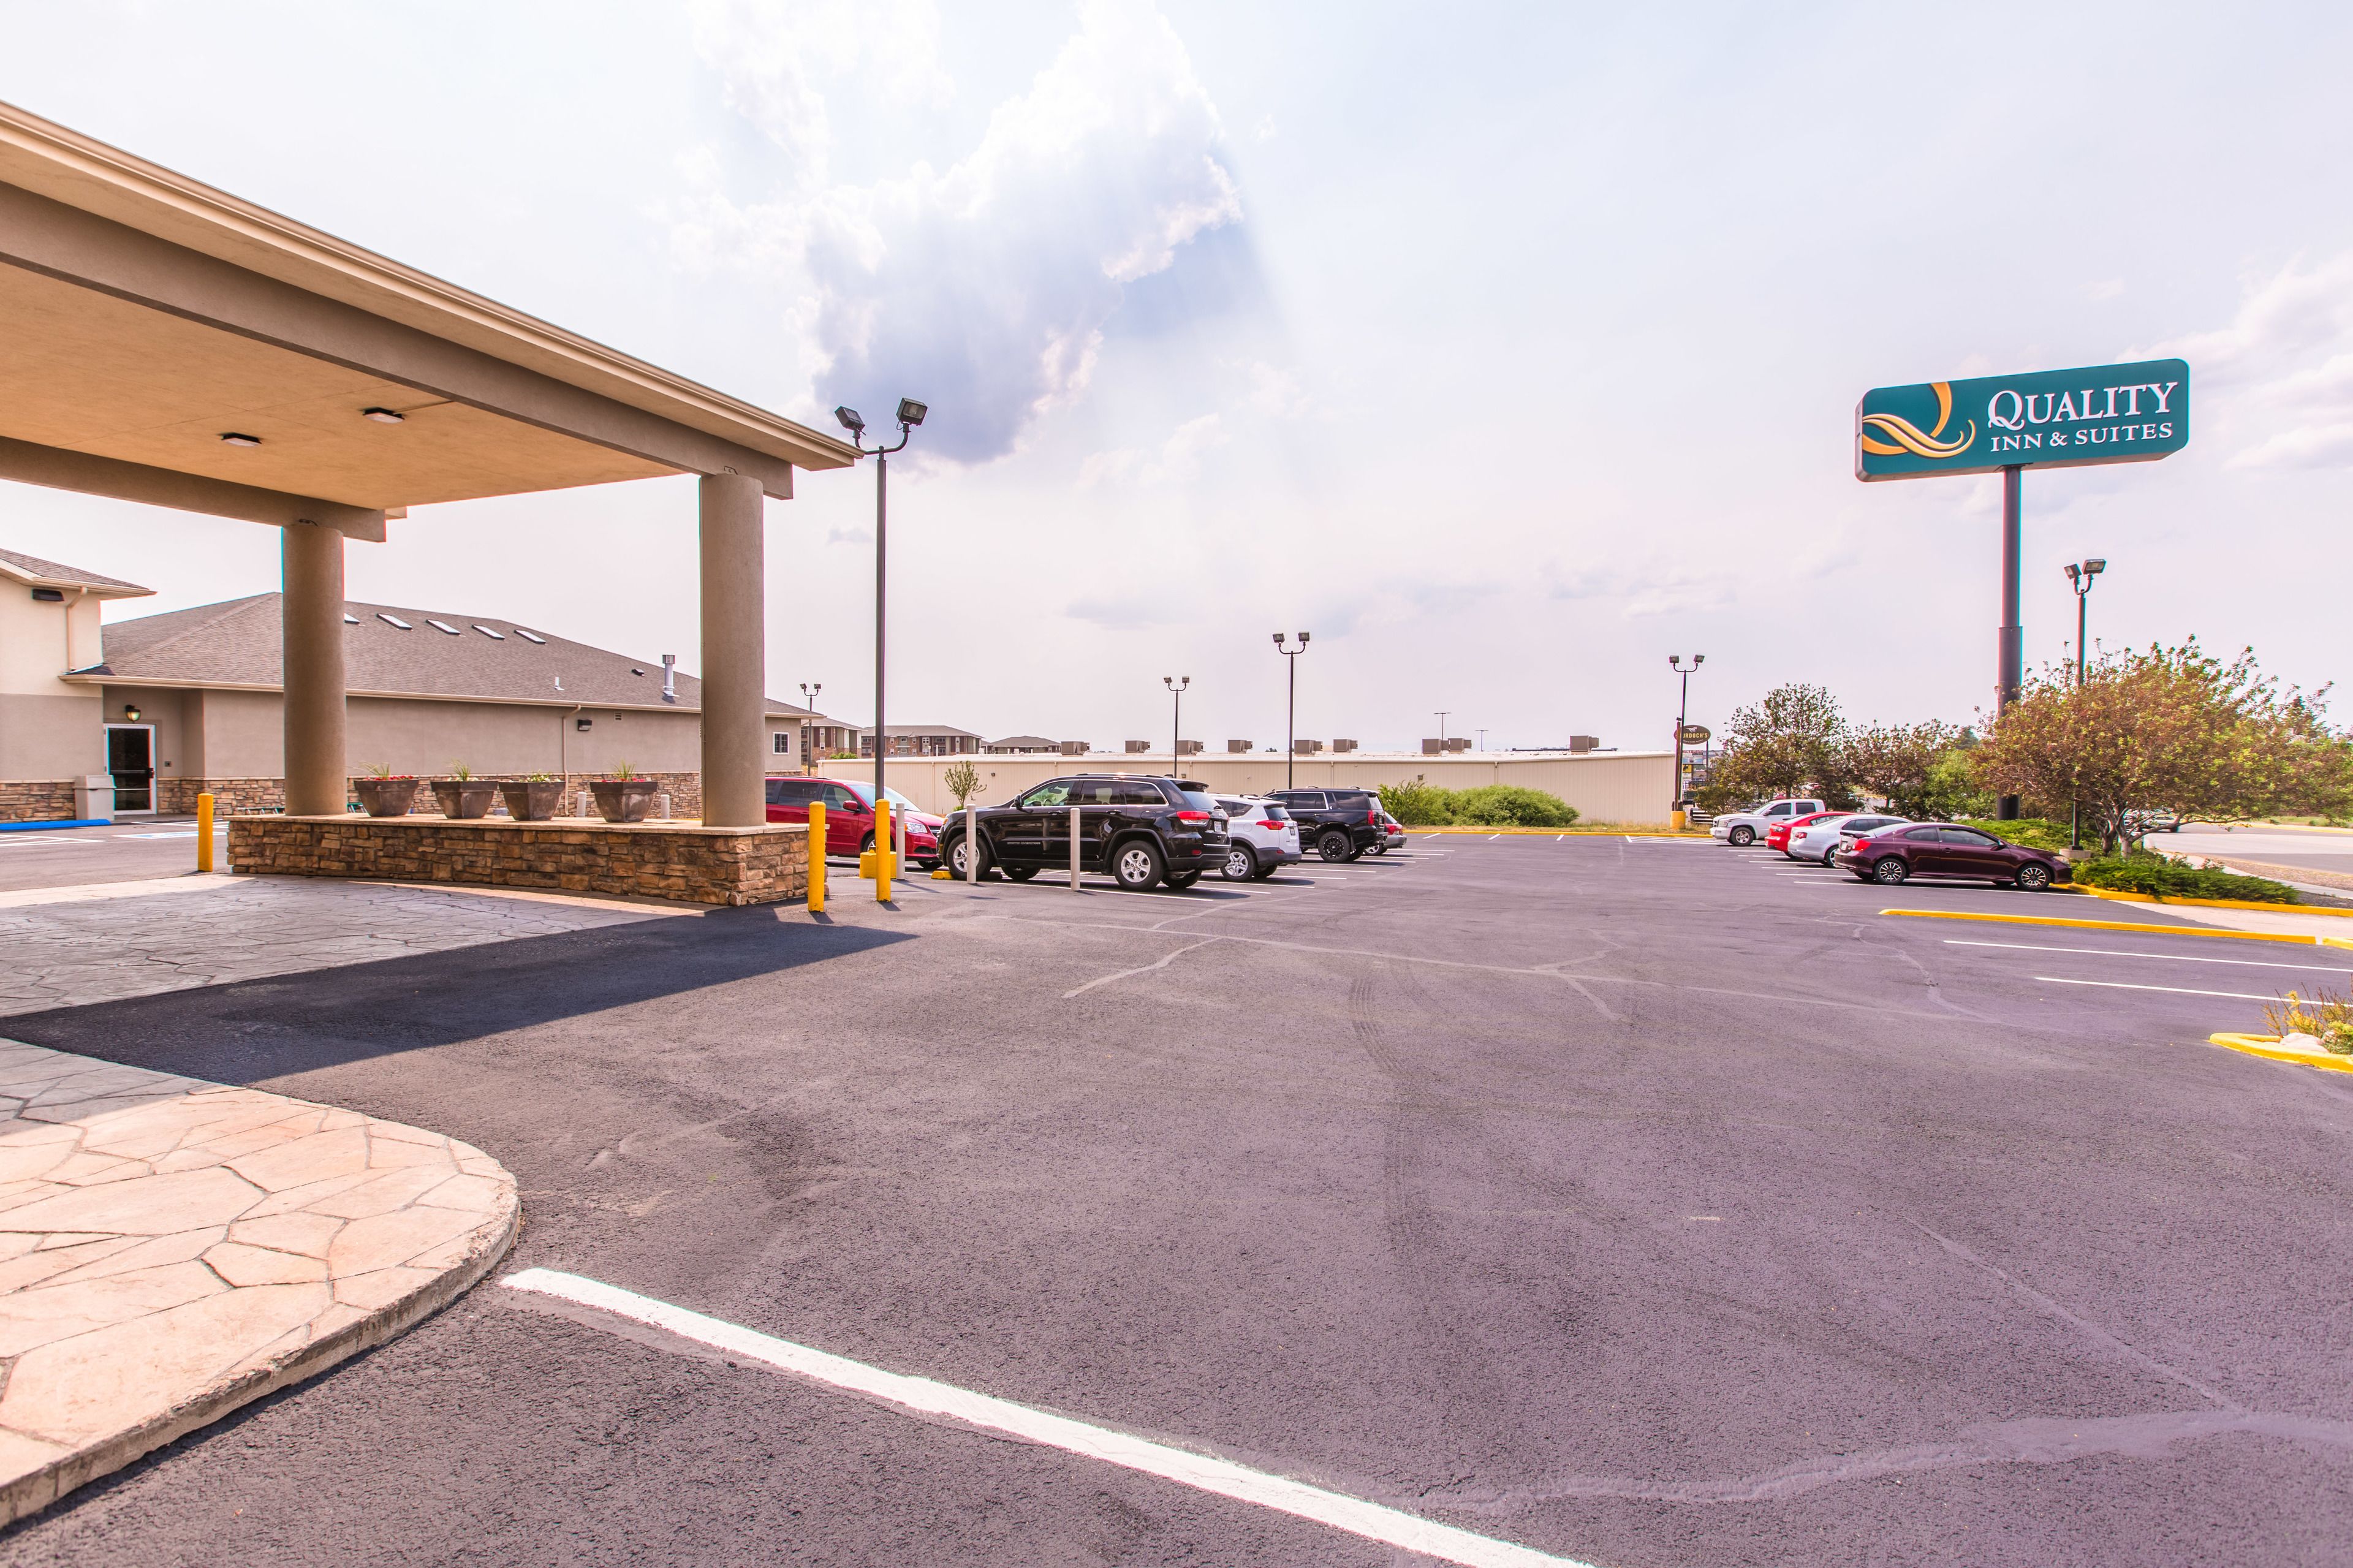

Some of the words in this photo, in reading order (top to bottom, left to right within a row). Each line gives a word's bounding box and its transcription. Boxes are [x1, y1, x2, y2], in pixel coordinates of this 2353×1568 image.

[1987, 382, 2178, 431] QUALITY
[1991, 433, 2042, 452] INN
[2049, 432, 2067, 447] &
[2075, 422, 2173, 445] SUITES
